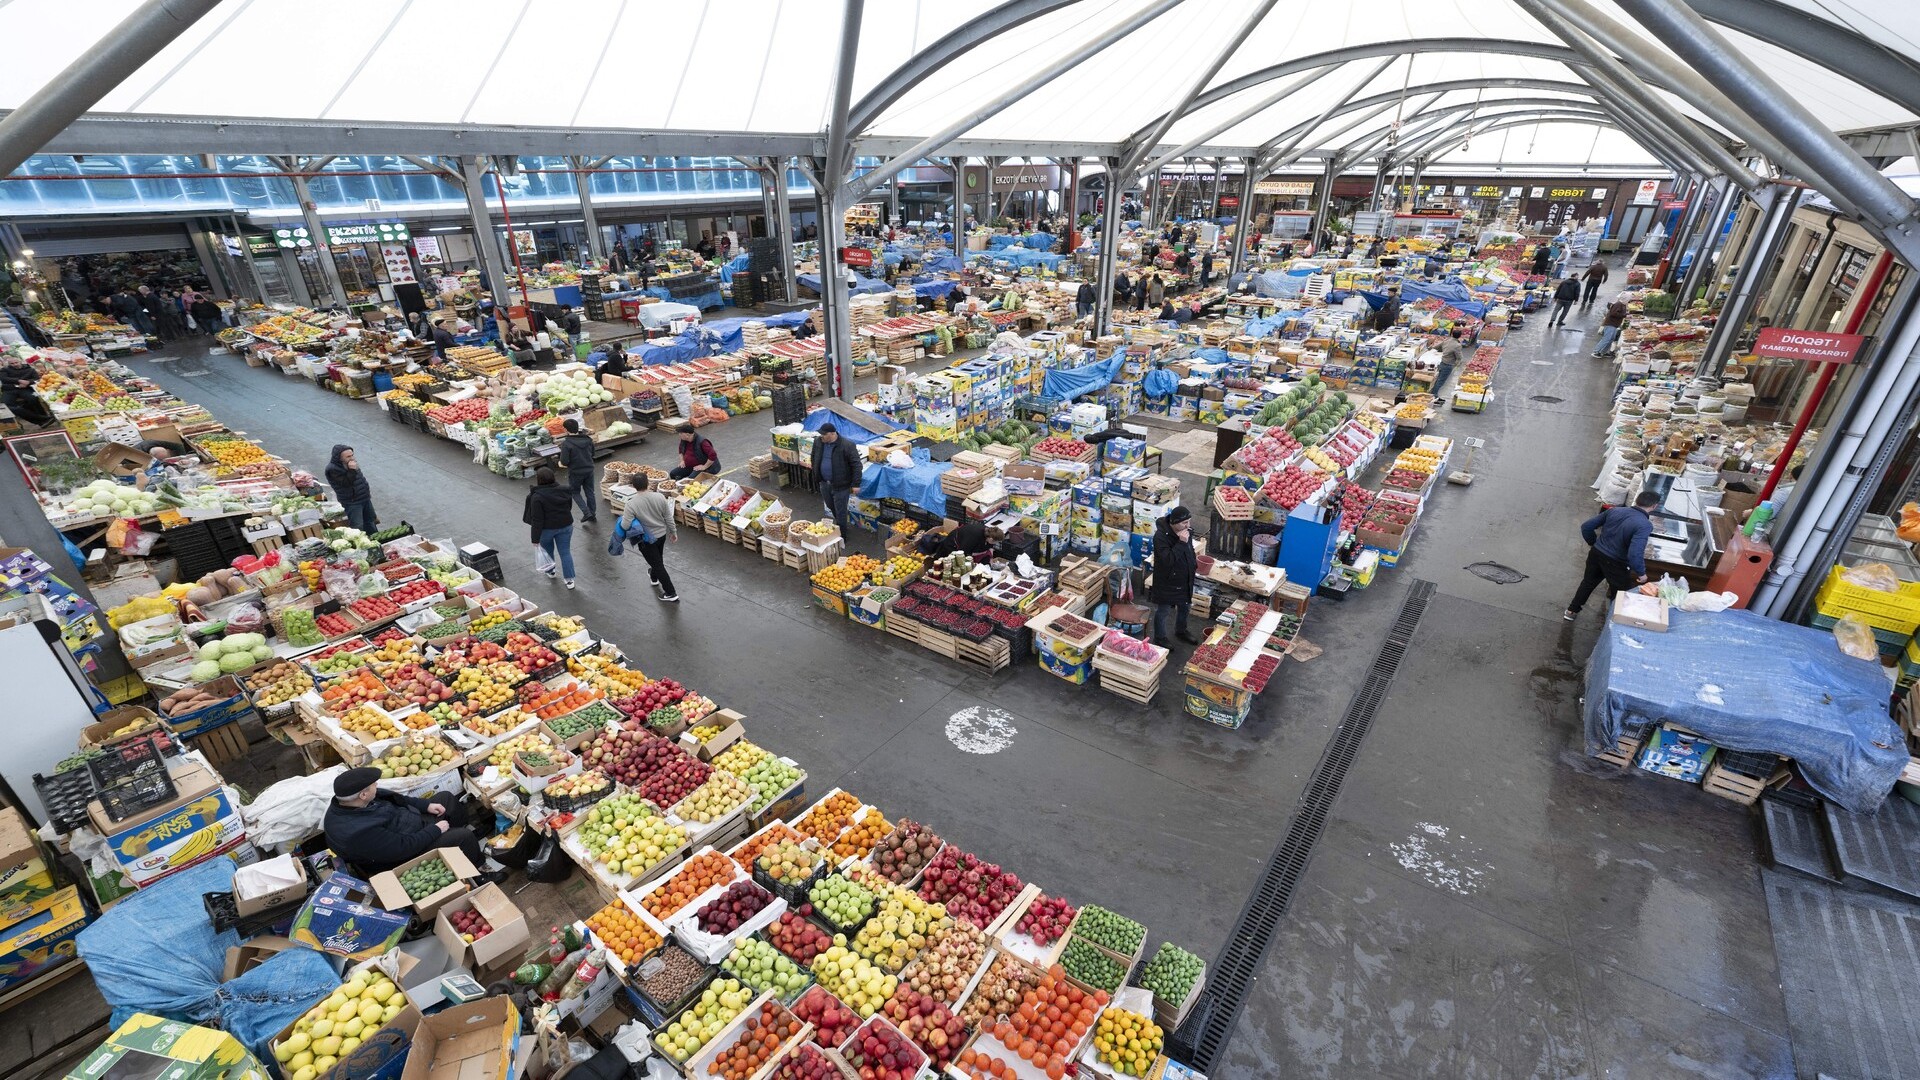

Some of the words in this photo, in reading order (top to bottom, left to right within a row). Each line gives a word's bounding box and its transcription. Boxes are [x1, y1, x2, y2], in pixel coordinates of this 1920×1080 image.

[1550, 188, 1586, 198] SƏBƏT
[327, 225, 377, 237] EKZOTİK
[1781, 335, 1833, 347] DİQQƏT
[1835, 340, 1840, 348] !
[1760, 344, 1799, 353] KAMERA
[1802, 347, 1849, 357] NƏZARƏTİ
[143, 855, 165, 868] Dole
[43, 919, 87, 943] BANANAS
